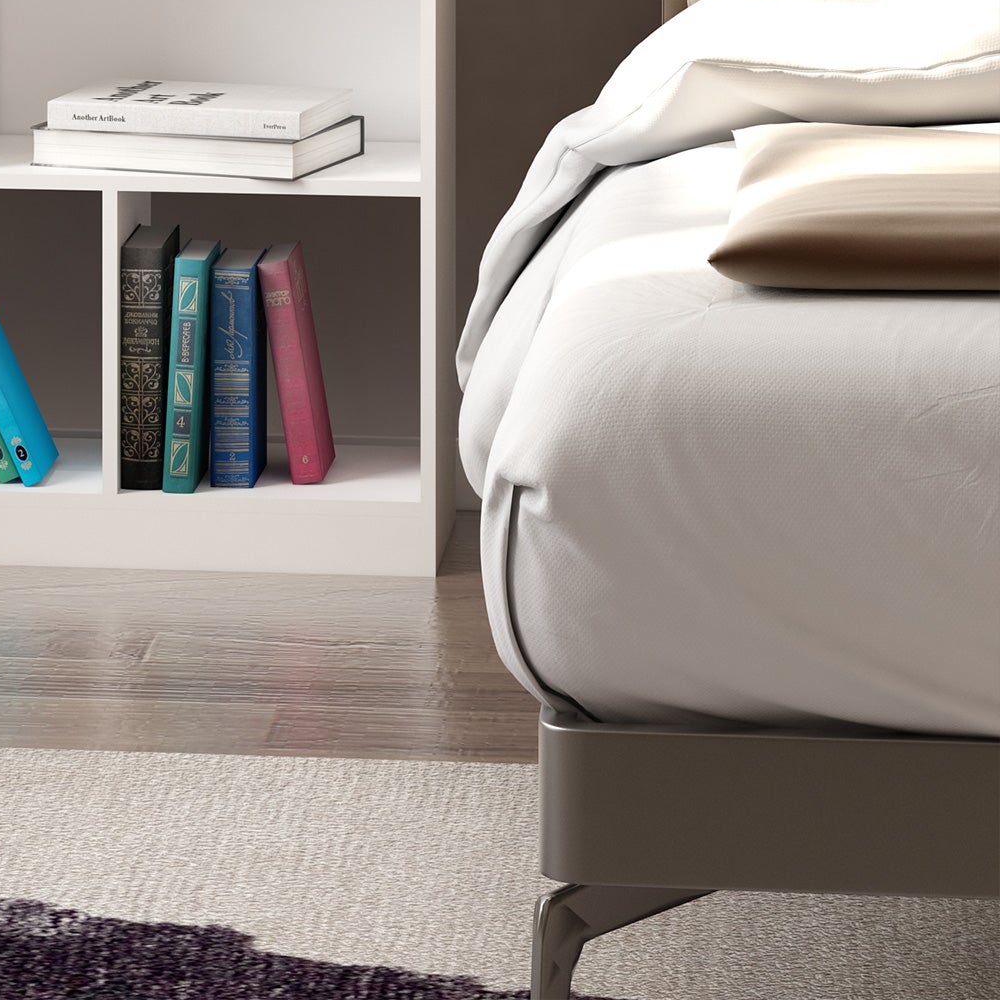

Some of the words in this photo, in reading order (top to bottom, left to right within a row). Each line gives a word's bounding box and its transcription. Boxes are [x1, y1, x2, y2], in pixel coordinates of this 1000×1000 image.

[72, 113, 98, 122] Another
[98, 114, 126, 123] ArtBook
[176, 416, 185, 428] 4
[17, 449, 26, 458] 2
[229, 452, 236, 461] 2
[302, 455, 309, 464] 6
